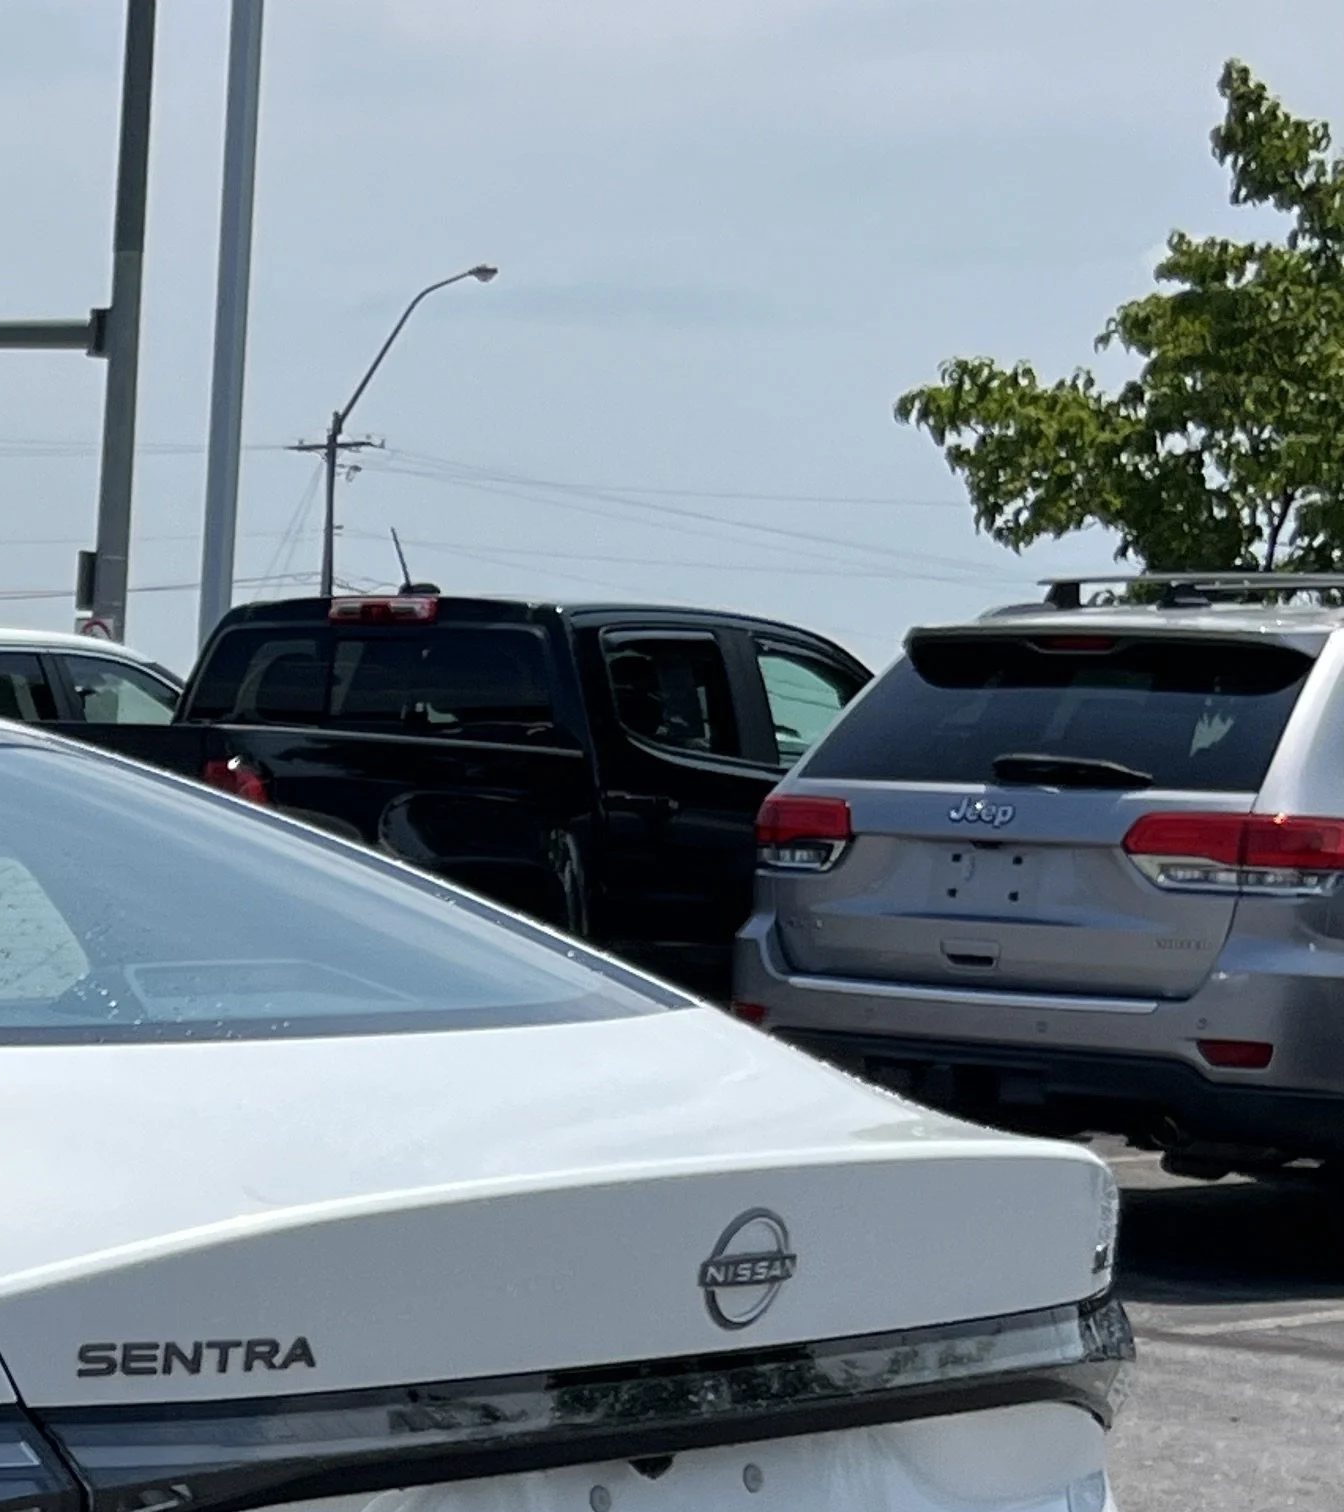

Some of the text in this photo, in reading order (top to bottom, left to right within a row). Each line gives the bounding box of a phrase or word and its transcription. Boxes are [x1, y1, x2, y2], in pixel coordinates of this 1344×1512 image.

[949, 796, 1014, 827] Jeep
[705, 1258, 796, 1284] NISSAN
[76, 1336, 316, 1378] SENTRA
